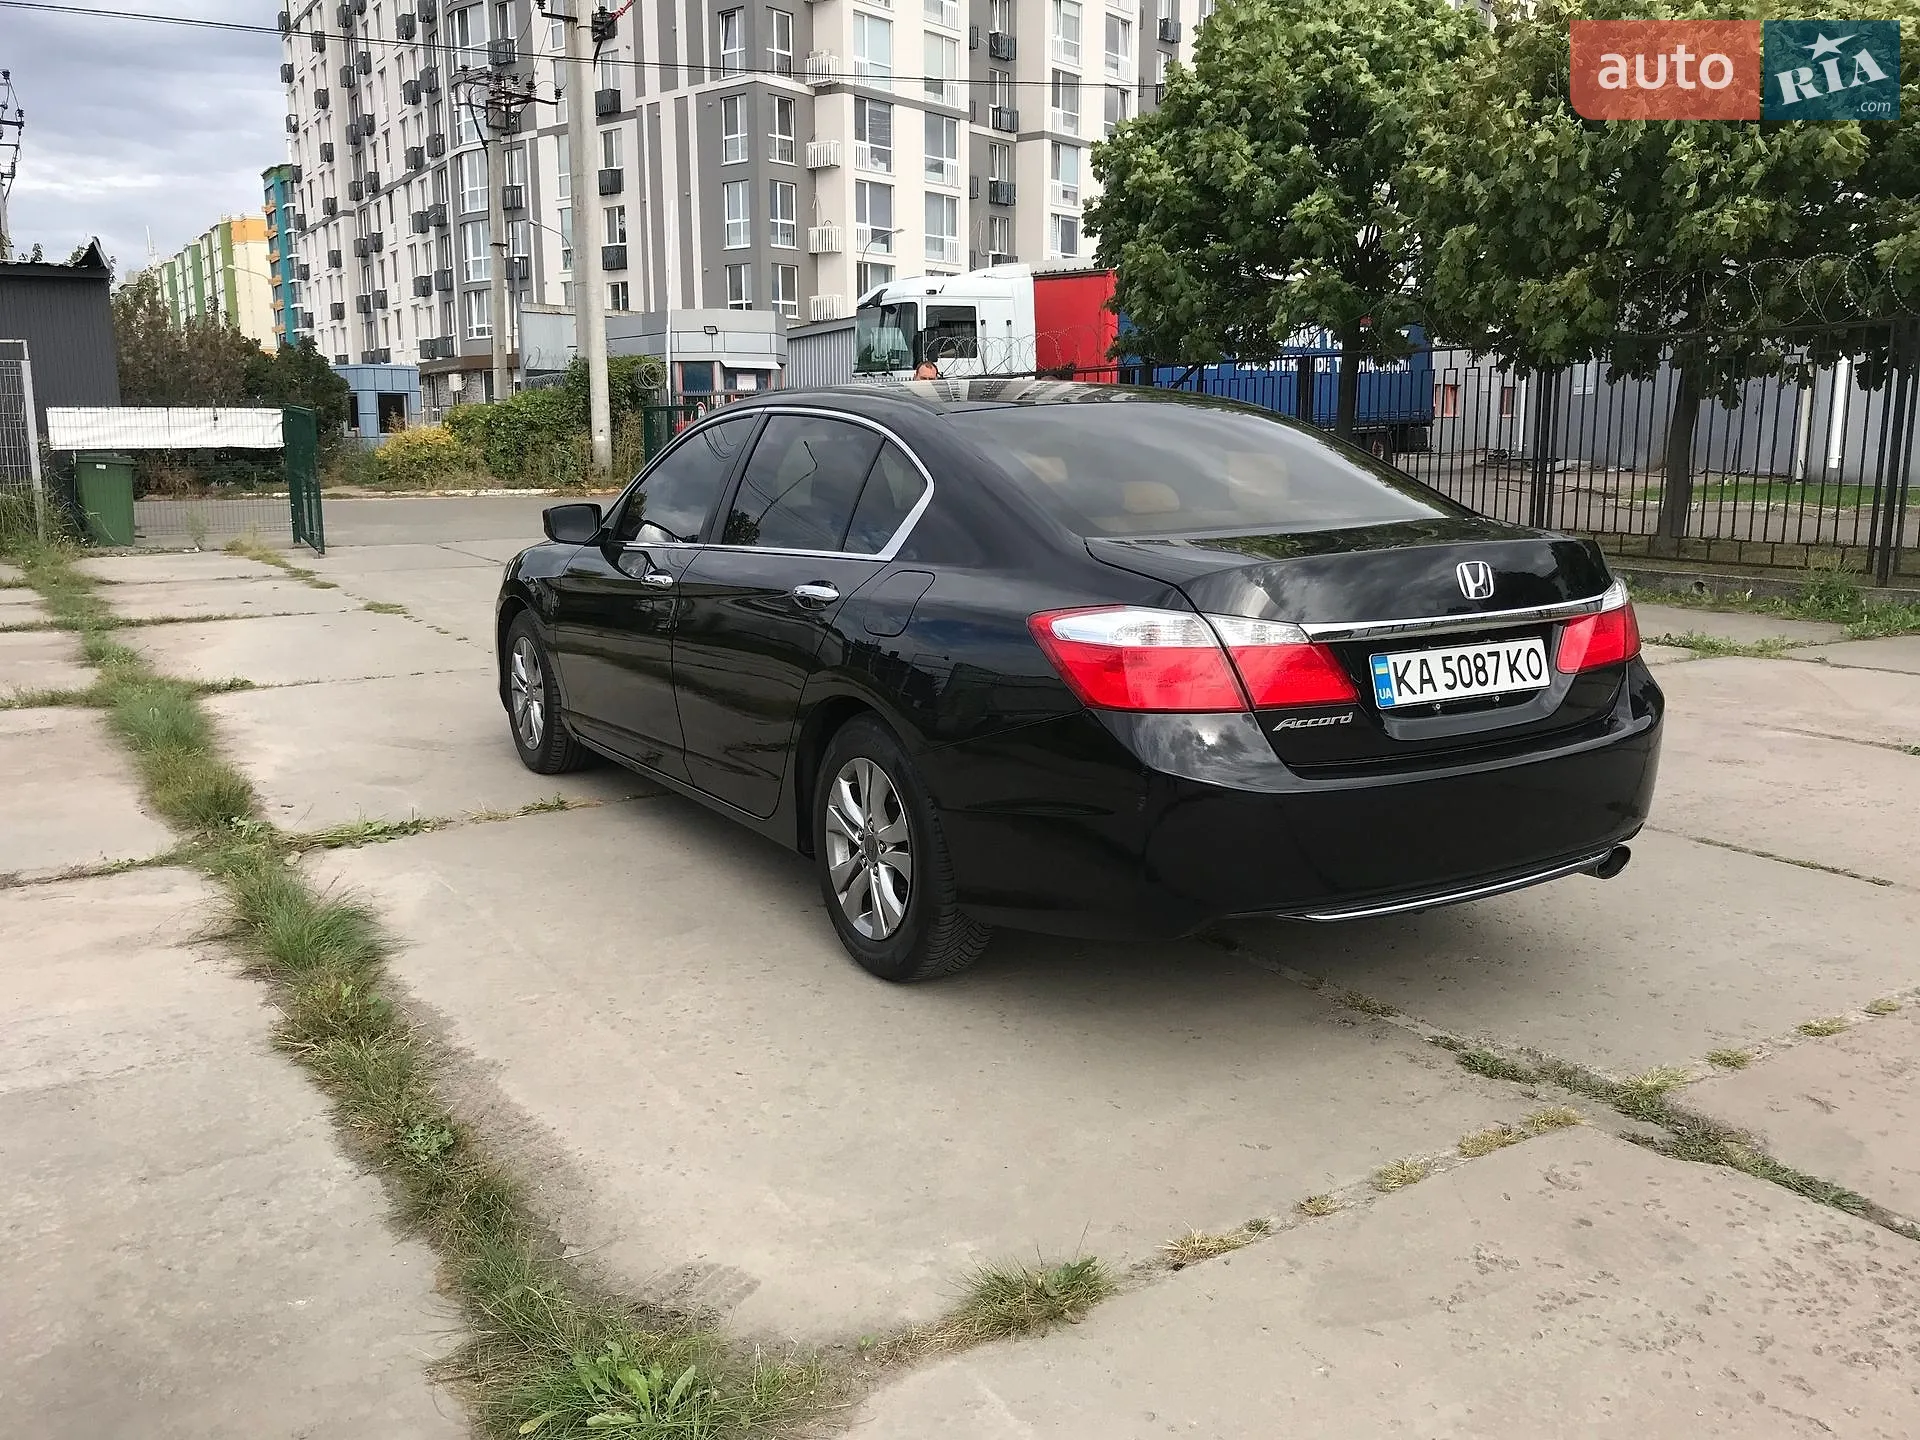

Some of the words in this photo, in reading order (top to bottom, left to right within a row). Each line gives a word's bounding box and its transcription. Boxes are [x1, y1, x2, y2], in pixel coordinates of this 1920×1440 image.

[1379, 688, 1393, 700] UA
[1392, 658, 1437, 696] KA
[1441, 650, 1500, 691] 5087
[1506, 647, 1543, 683] KO
[1272, 711, 1354, 732] Accord
